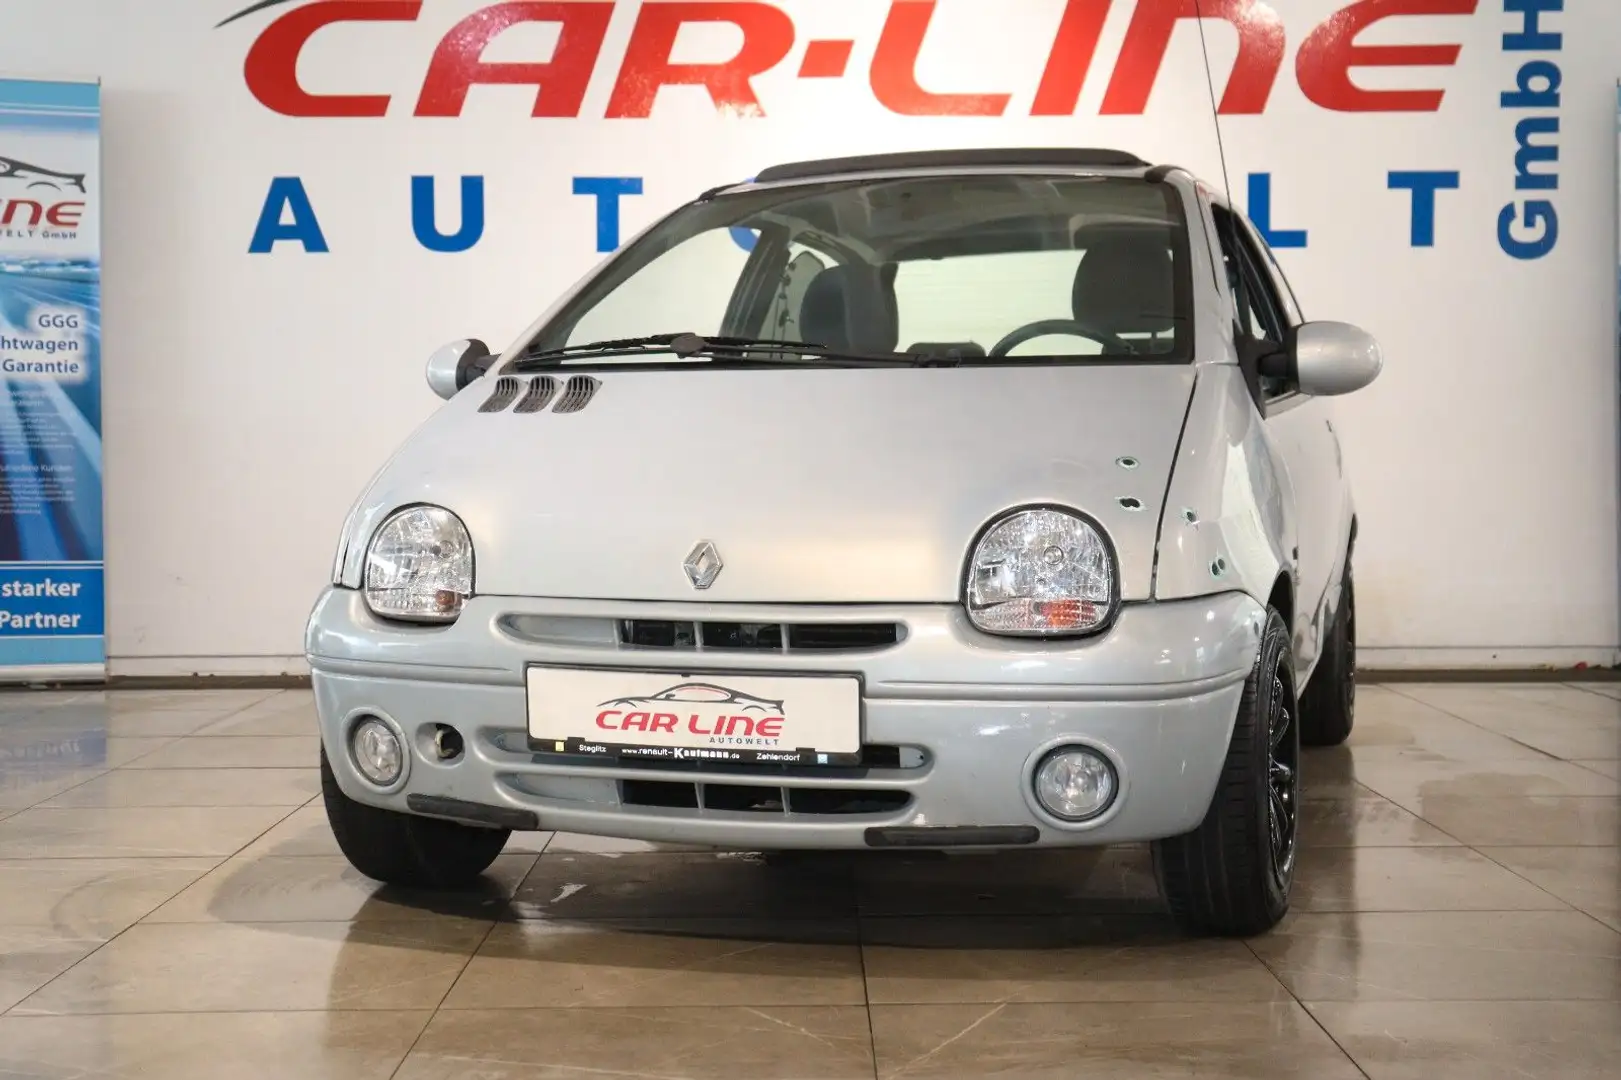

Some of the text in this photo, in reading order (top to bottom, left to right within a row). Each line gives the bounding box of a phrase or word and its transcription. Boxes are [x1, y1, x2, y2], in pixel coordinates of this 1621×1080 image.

[1496, 0, 1564, 260] GmbH
[38, 314, 79, 329] GGG
[2, 359, 79, 373] Garantie
[2, 578, 81, 597] starker
[0, 610, 81, 628] Partner
[595, 710, 785, 737] CAR LINE
[709, 736, 779, 746] AUTOWELT
[578, 743, 606, 753] Steglitz
[756, 752, 801, 762] Zehlendorf
